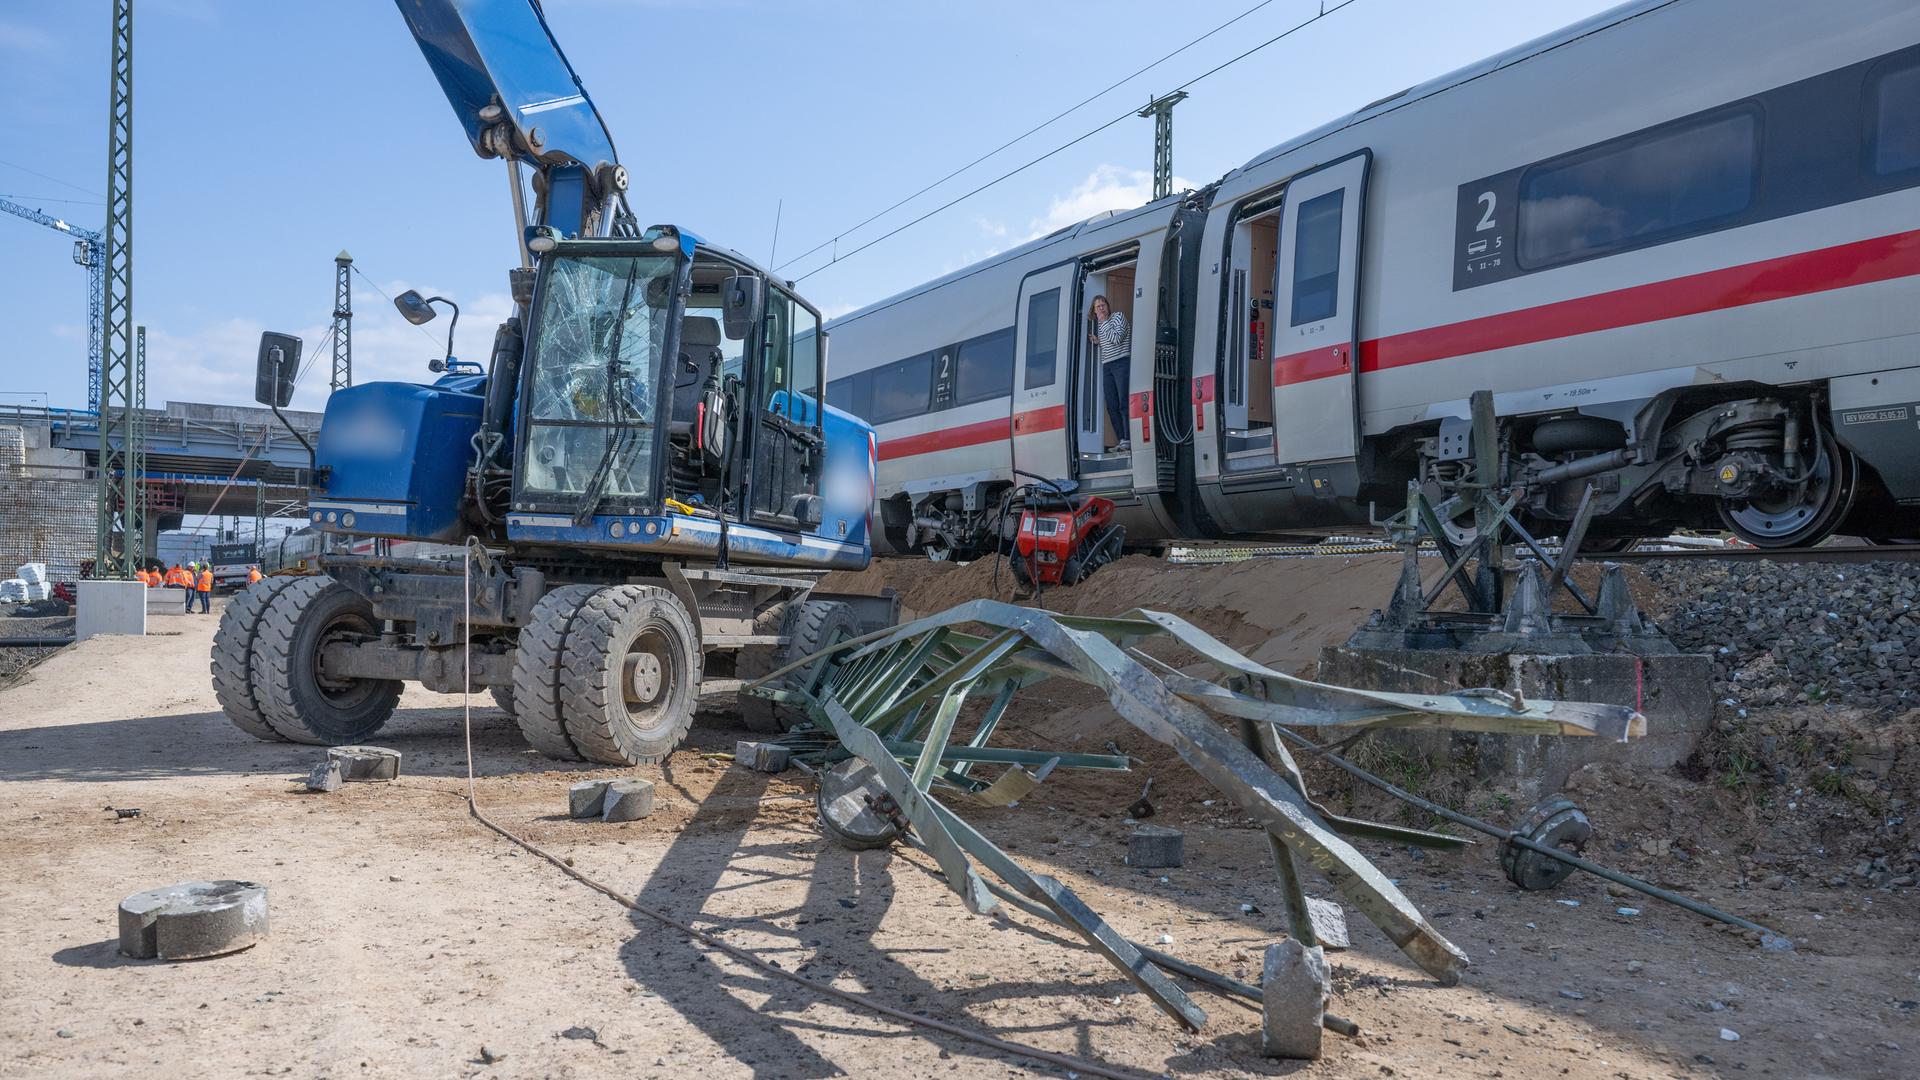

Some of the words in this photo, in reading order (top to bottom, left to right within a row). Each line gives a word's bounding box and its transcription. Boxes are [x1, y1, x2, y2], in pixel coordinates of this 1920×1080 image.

[1476, 191, 1497, 232] 2
[1495, 236, 1502, 248] 5
[940, 354, 949, 379] 2
